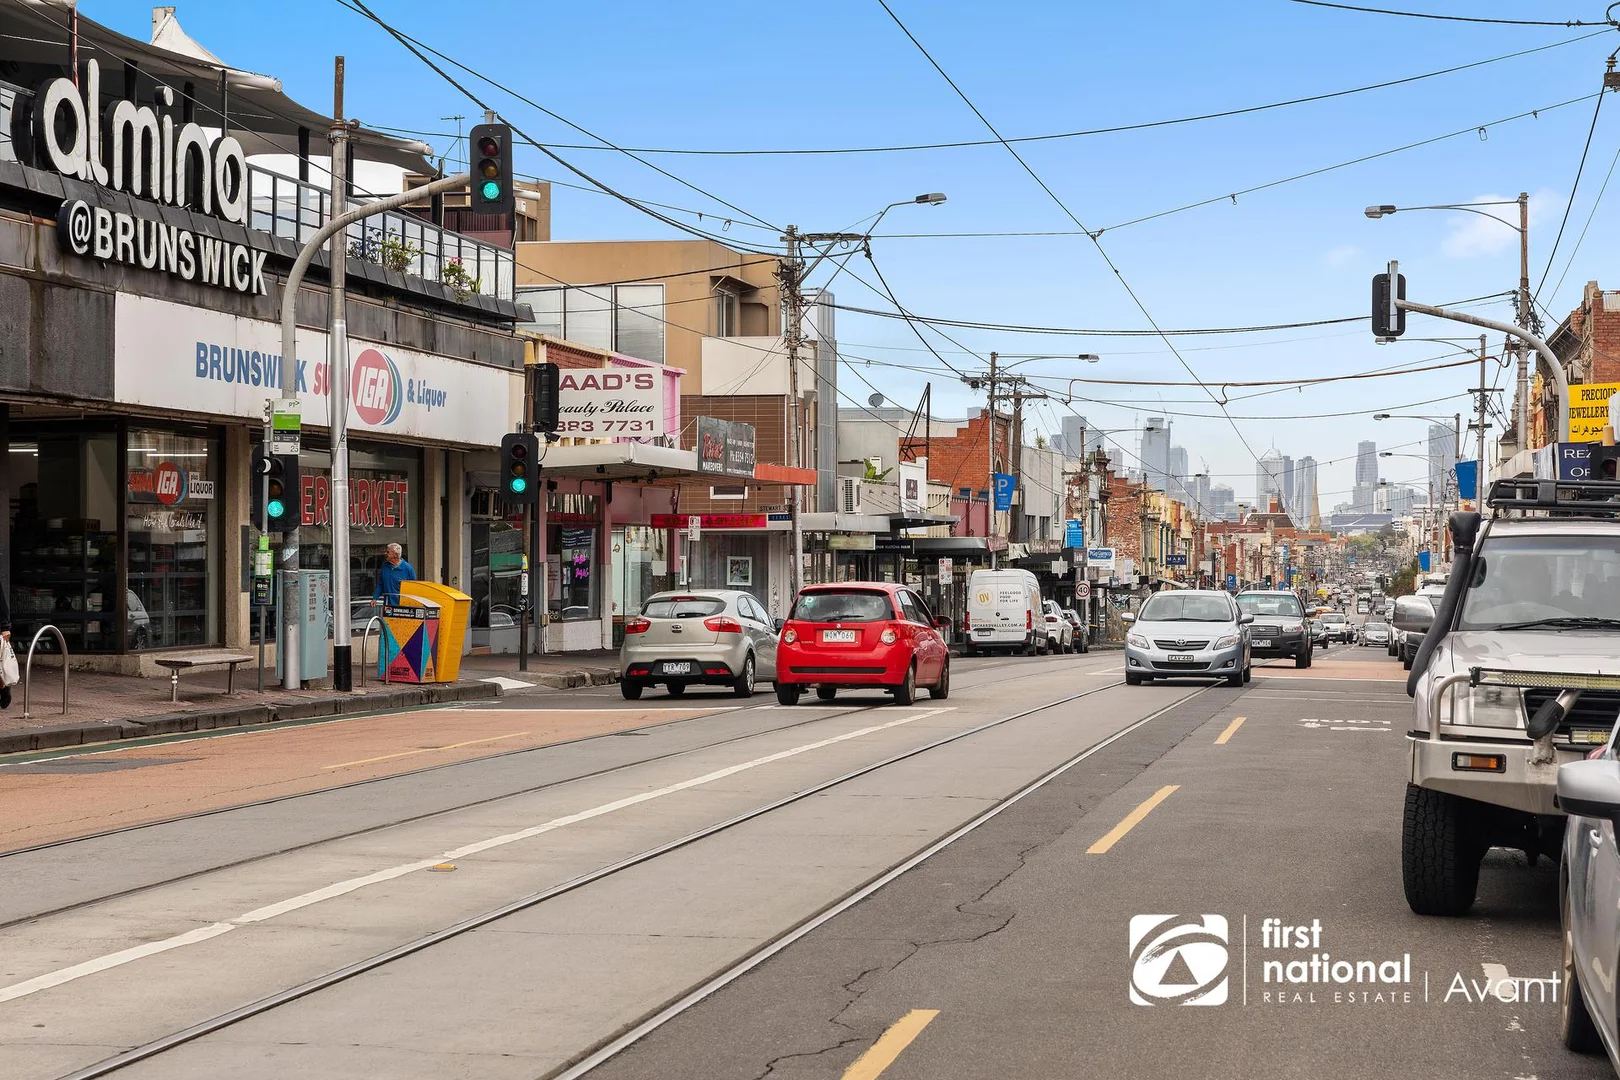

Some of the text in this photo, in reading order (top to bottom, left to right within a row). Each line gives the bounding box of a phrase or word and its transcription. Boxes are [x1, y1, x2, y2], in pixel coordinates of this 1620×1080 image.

[66, 200, 268, 297] @BRUNSWICK
[195, 341, 308, 393] BRUNSWIK
[559, 373, 654, 390] AAD'S
[407, 378, 447, 412] & Liquor
[1581, 387, 1617, 400] PRECIOUS
[558, 398, 655, 418] eauty Palace
[1568, 405, 1609, 419] JEWELLERY
[602, 420, 654, 432] 7731
[156, 470, 179, 495] IGA
[190, 482, 213, 495] LIQUOR
[997, 479, 1008, 492] P
[301, 475, 408, 528] ERARKET
[979, 592, 989, 603] OV
[1079, 586, 1088, 594] 40
